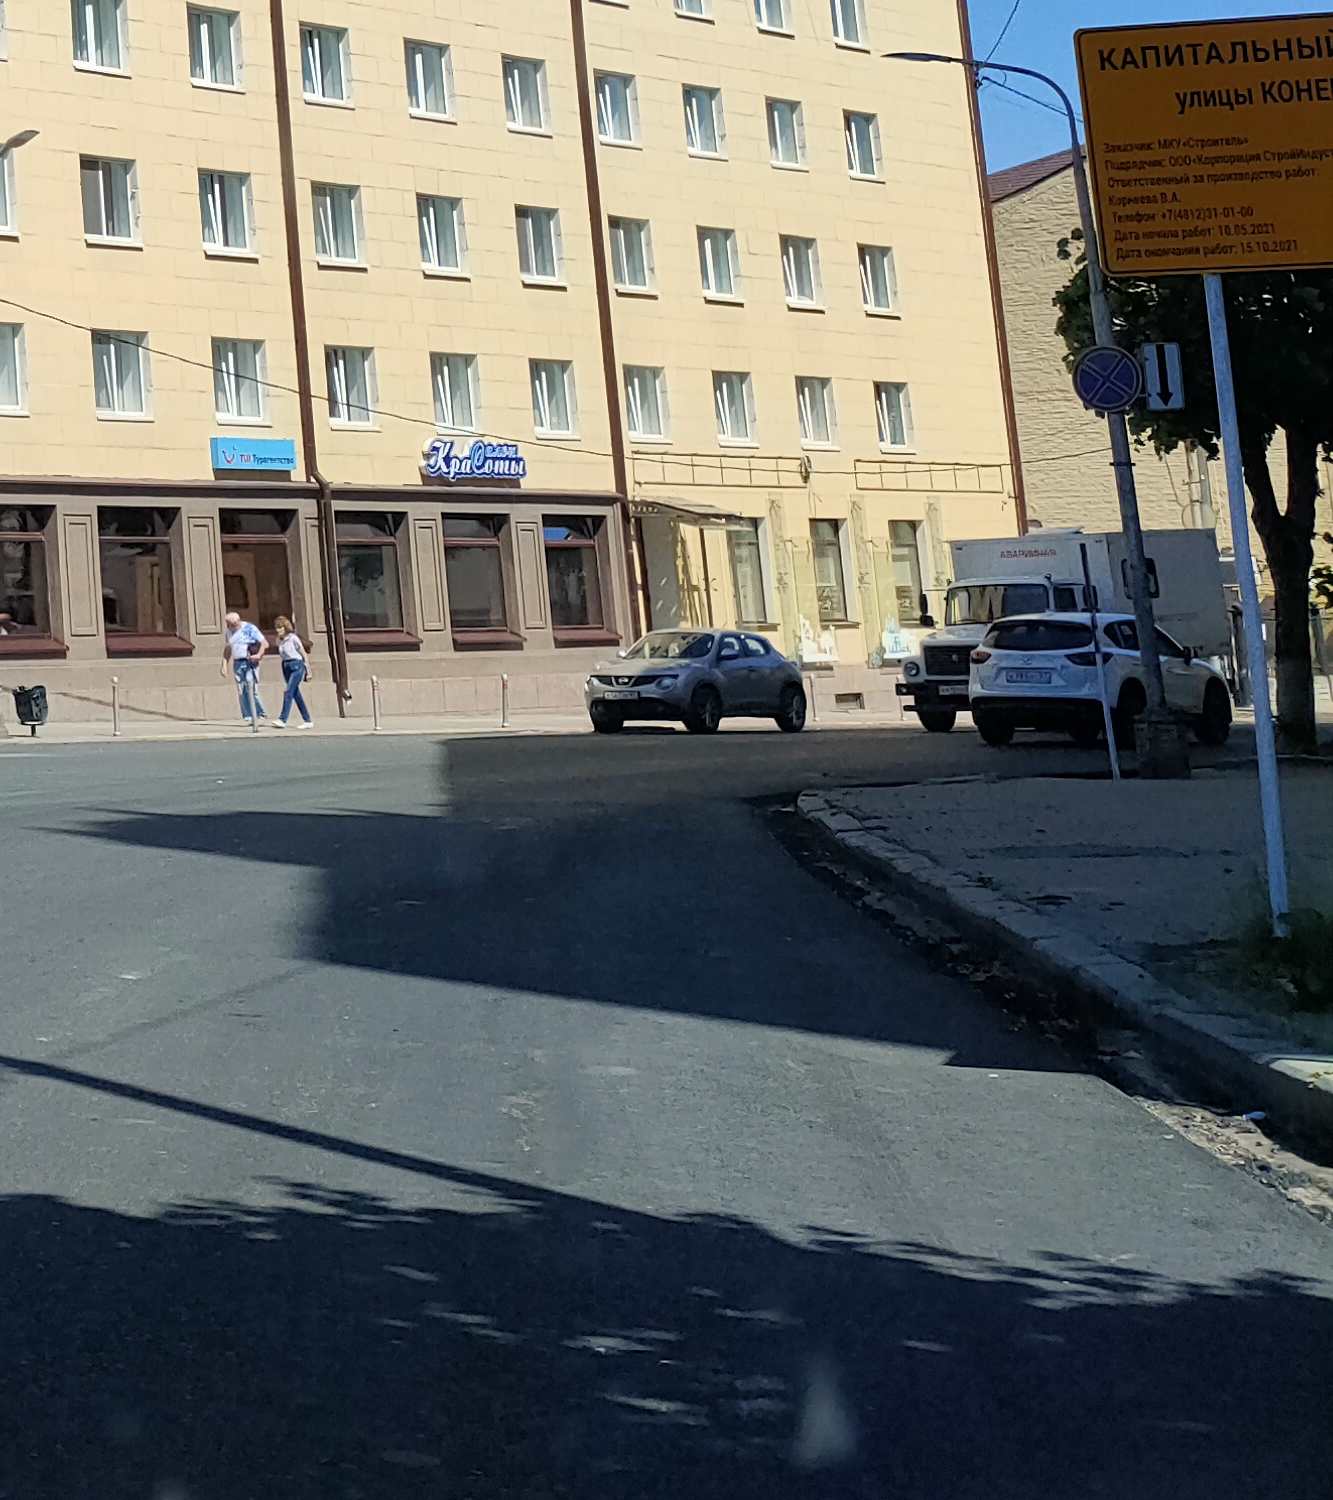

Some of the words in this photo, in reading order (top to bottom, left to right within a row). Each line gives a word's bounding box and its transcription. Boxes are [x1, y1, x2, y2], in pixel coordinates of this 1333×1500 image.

[1175, 87, 1254, 114] улицы
[1260, 77, 1333, 104] КОНЕ
[1169, 154, 1191, 168] ООО
[1108, 172, 1191, 189] Ответственный
[1192, 173, 1205, 184] за
[1207, 169, 1283, 185] производство
[1161, 205, 1254, 221] +7(4812)31-01-00
[1114, 229, 1140, 243] Дата
[1142, 228, 1179, 240] начала
[1218, 222, 1275, 237] 10.05.2021
[1116, 247, 1142, 261] Дата
[1144, 245, 1201, 258] окончания
[1240, 239, 1298, 255] 15.10.2021
